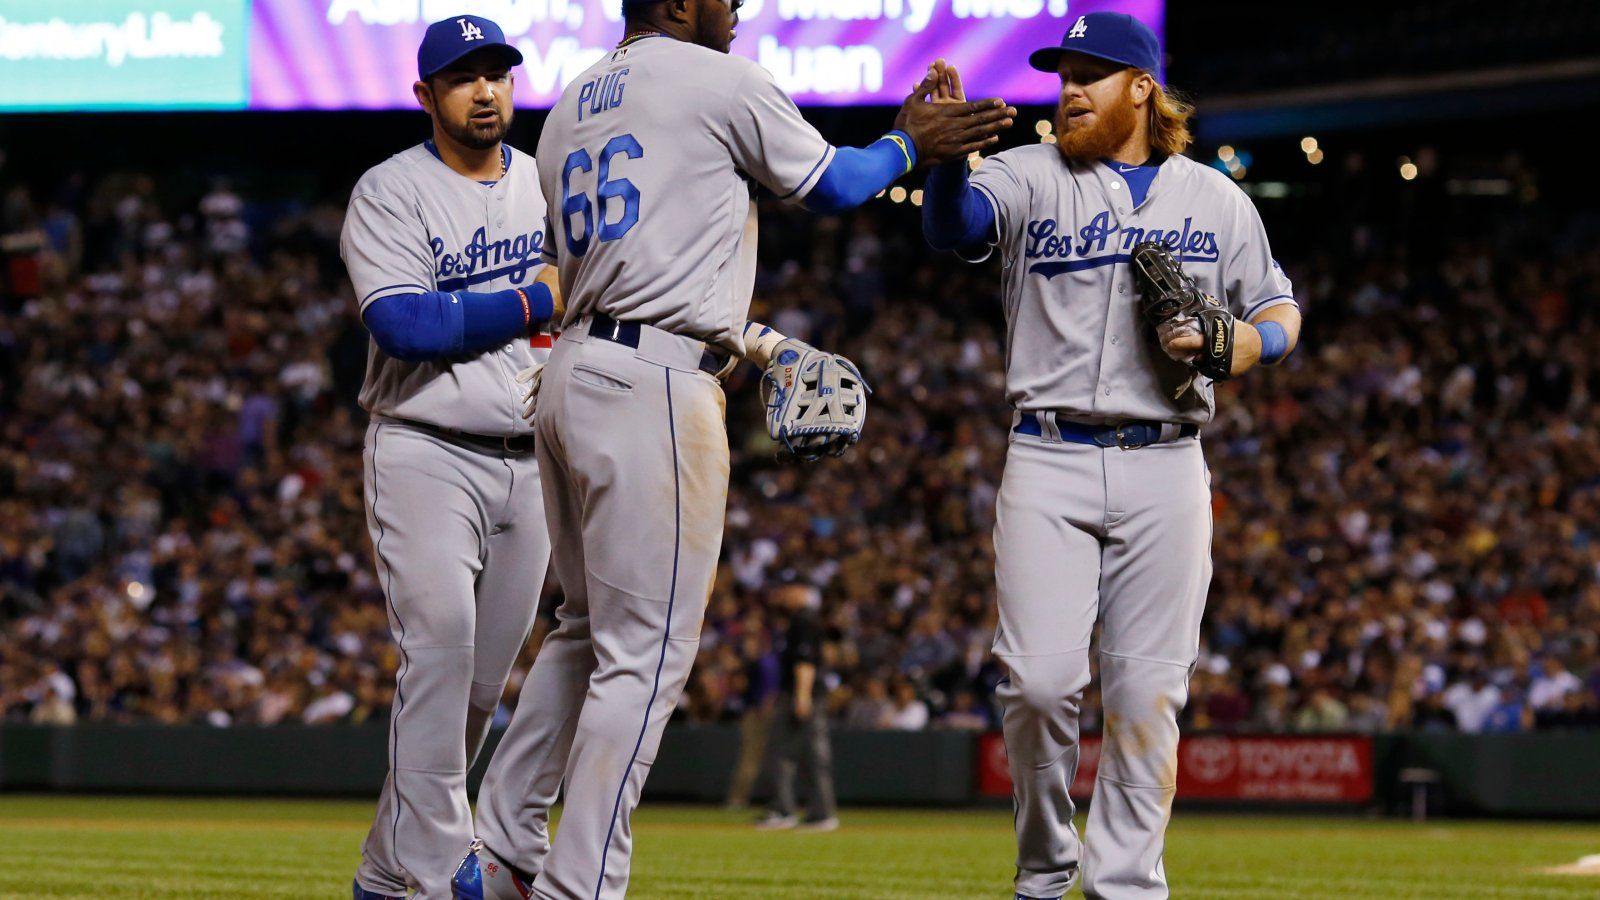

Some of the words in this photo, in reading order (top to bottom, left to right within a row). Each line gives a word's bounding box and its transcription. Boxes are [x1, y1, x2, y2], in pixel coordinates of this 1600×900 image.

[0, 11, 224, 67] enturyLink
[457, 18, 485, 41] LA
[578, 68, 629, 122] PUIG
[562, 133, 643, 257] 66
[430, 236, 469, 278] Los
[463, 225, 544, 284] Ange
[1026, 218, 1073, 258] Los
[1075, 210, 1219, 255] Angeles
[1213, 317, 1225, 354] Wilson
[1237, 739, 1361, 778] TOYOTA
